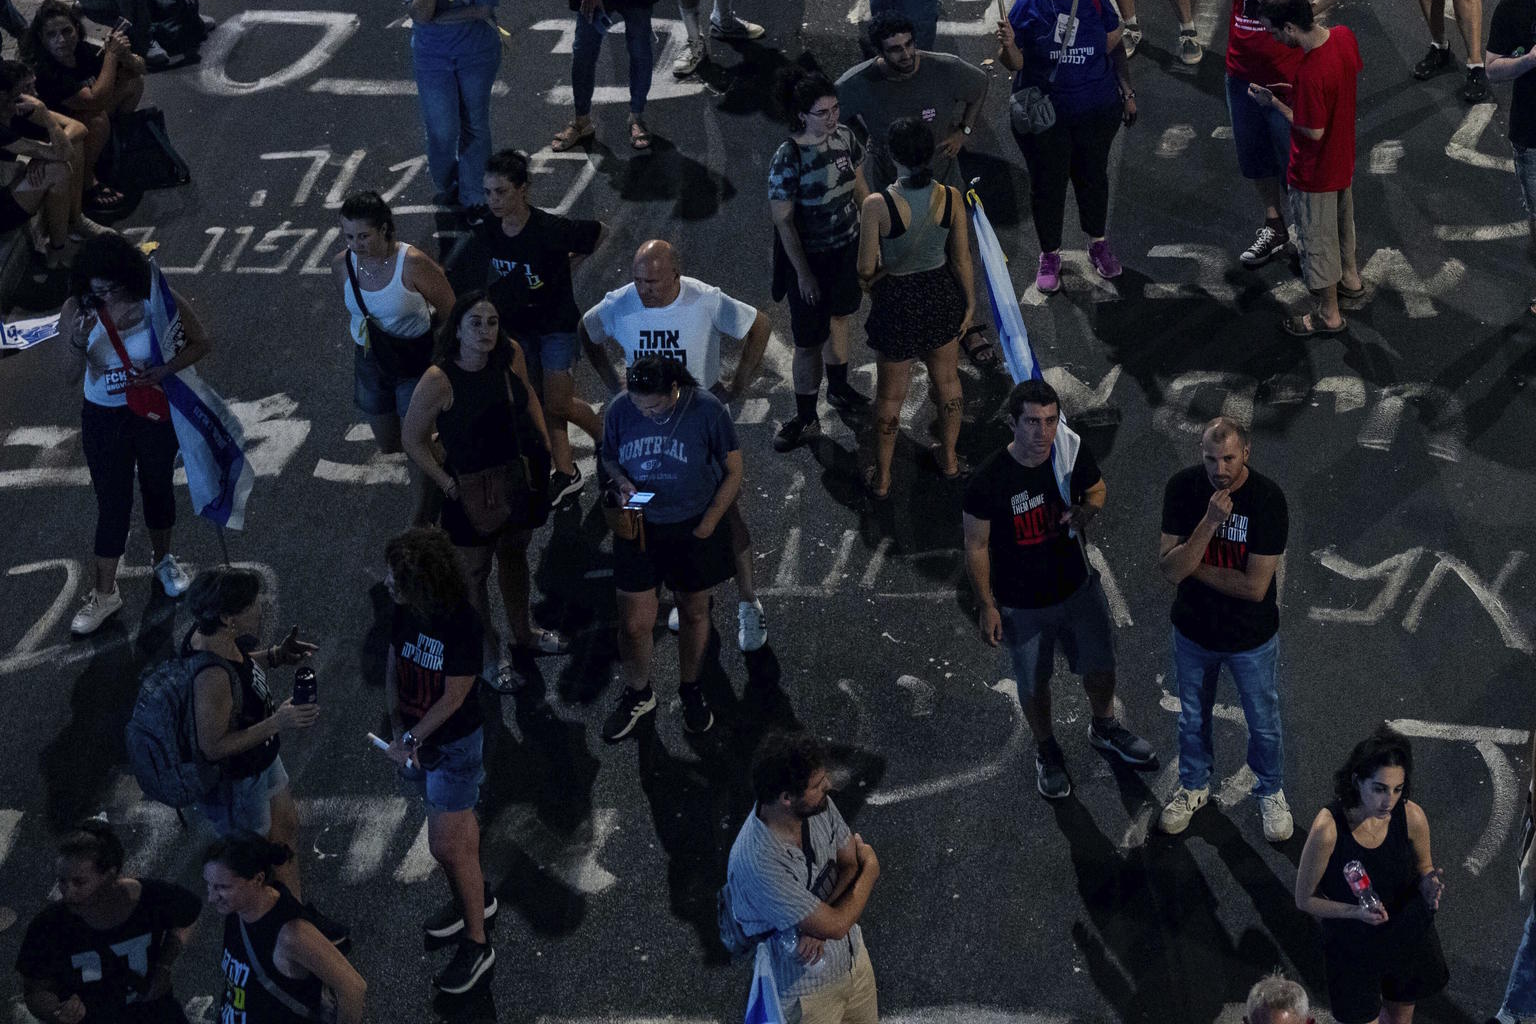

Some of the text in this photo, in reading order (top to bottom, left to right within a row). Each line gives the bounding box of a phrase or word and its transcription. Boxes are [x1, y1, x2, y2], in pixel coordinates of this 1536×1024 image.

[1061, 55, 1086, 64] לכולם
[1069, 47, 1094, 56] שירות
[640, 330, 680, 349] אתה
[1011, 489, 1030, 506] BRING
[1013, 493, 1046, 516] THEM HOME
[1227, 528, 1248, 543] אותם
[419, 650, 445, 671] אותם
